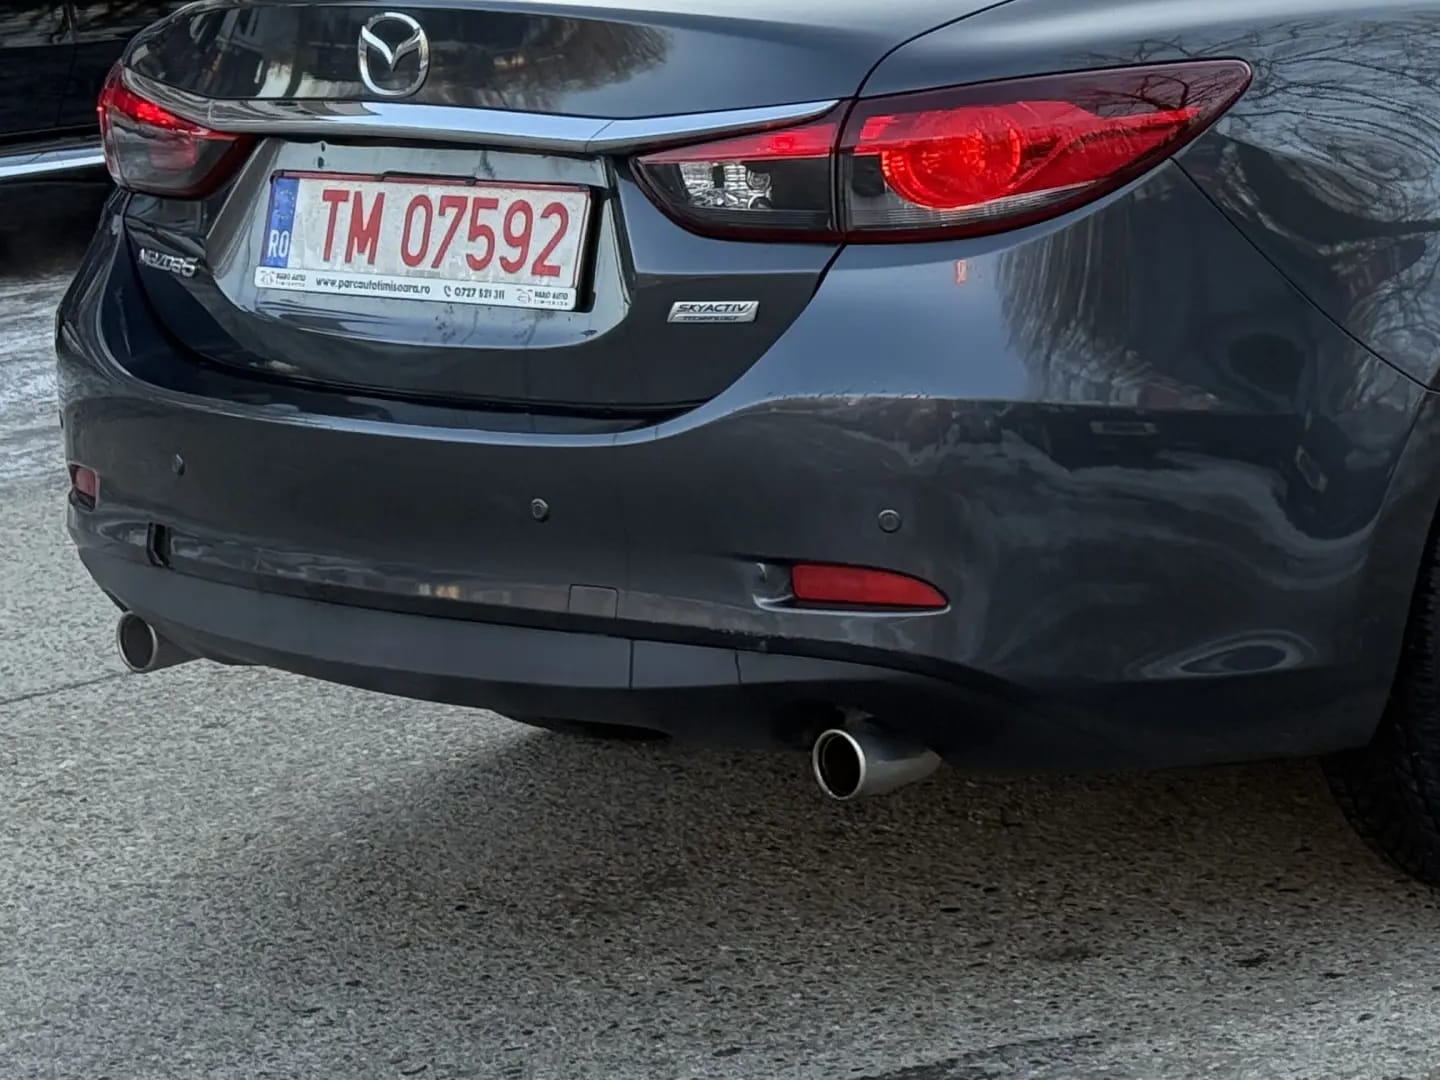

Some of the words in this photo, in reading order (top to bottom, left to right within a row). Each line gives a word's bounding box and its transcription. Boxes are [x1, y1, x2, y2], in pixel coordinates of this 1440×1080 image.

[321, 189, 386, 265] TM
[400, 193, 570, 278] 07592
[266, 229, 290, 259] RO
[315, 276, 431, 295] www.parcautotimisoara.ro
[454, 286, 477, 299] 0727
[676, 302, 750, 313] SKYACTIV
